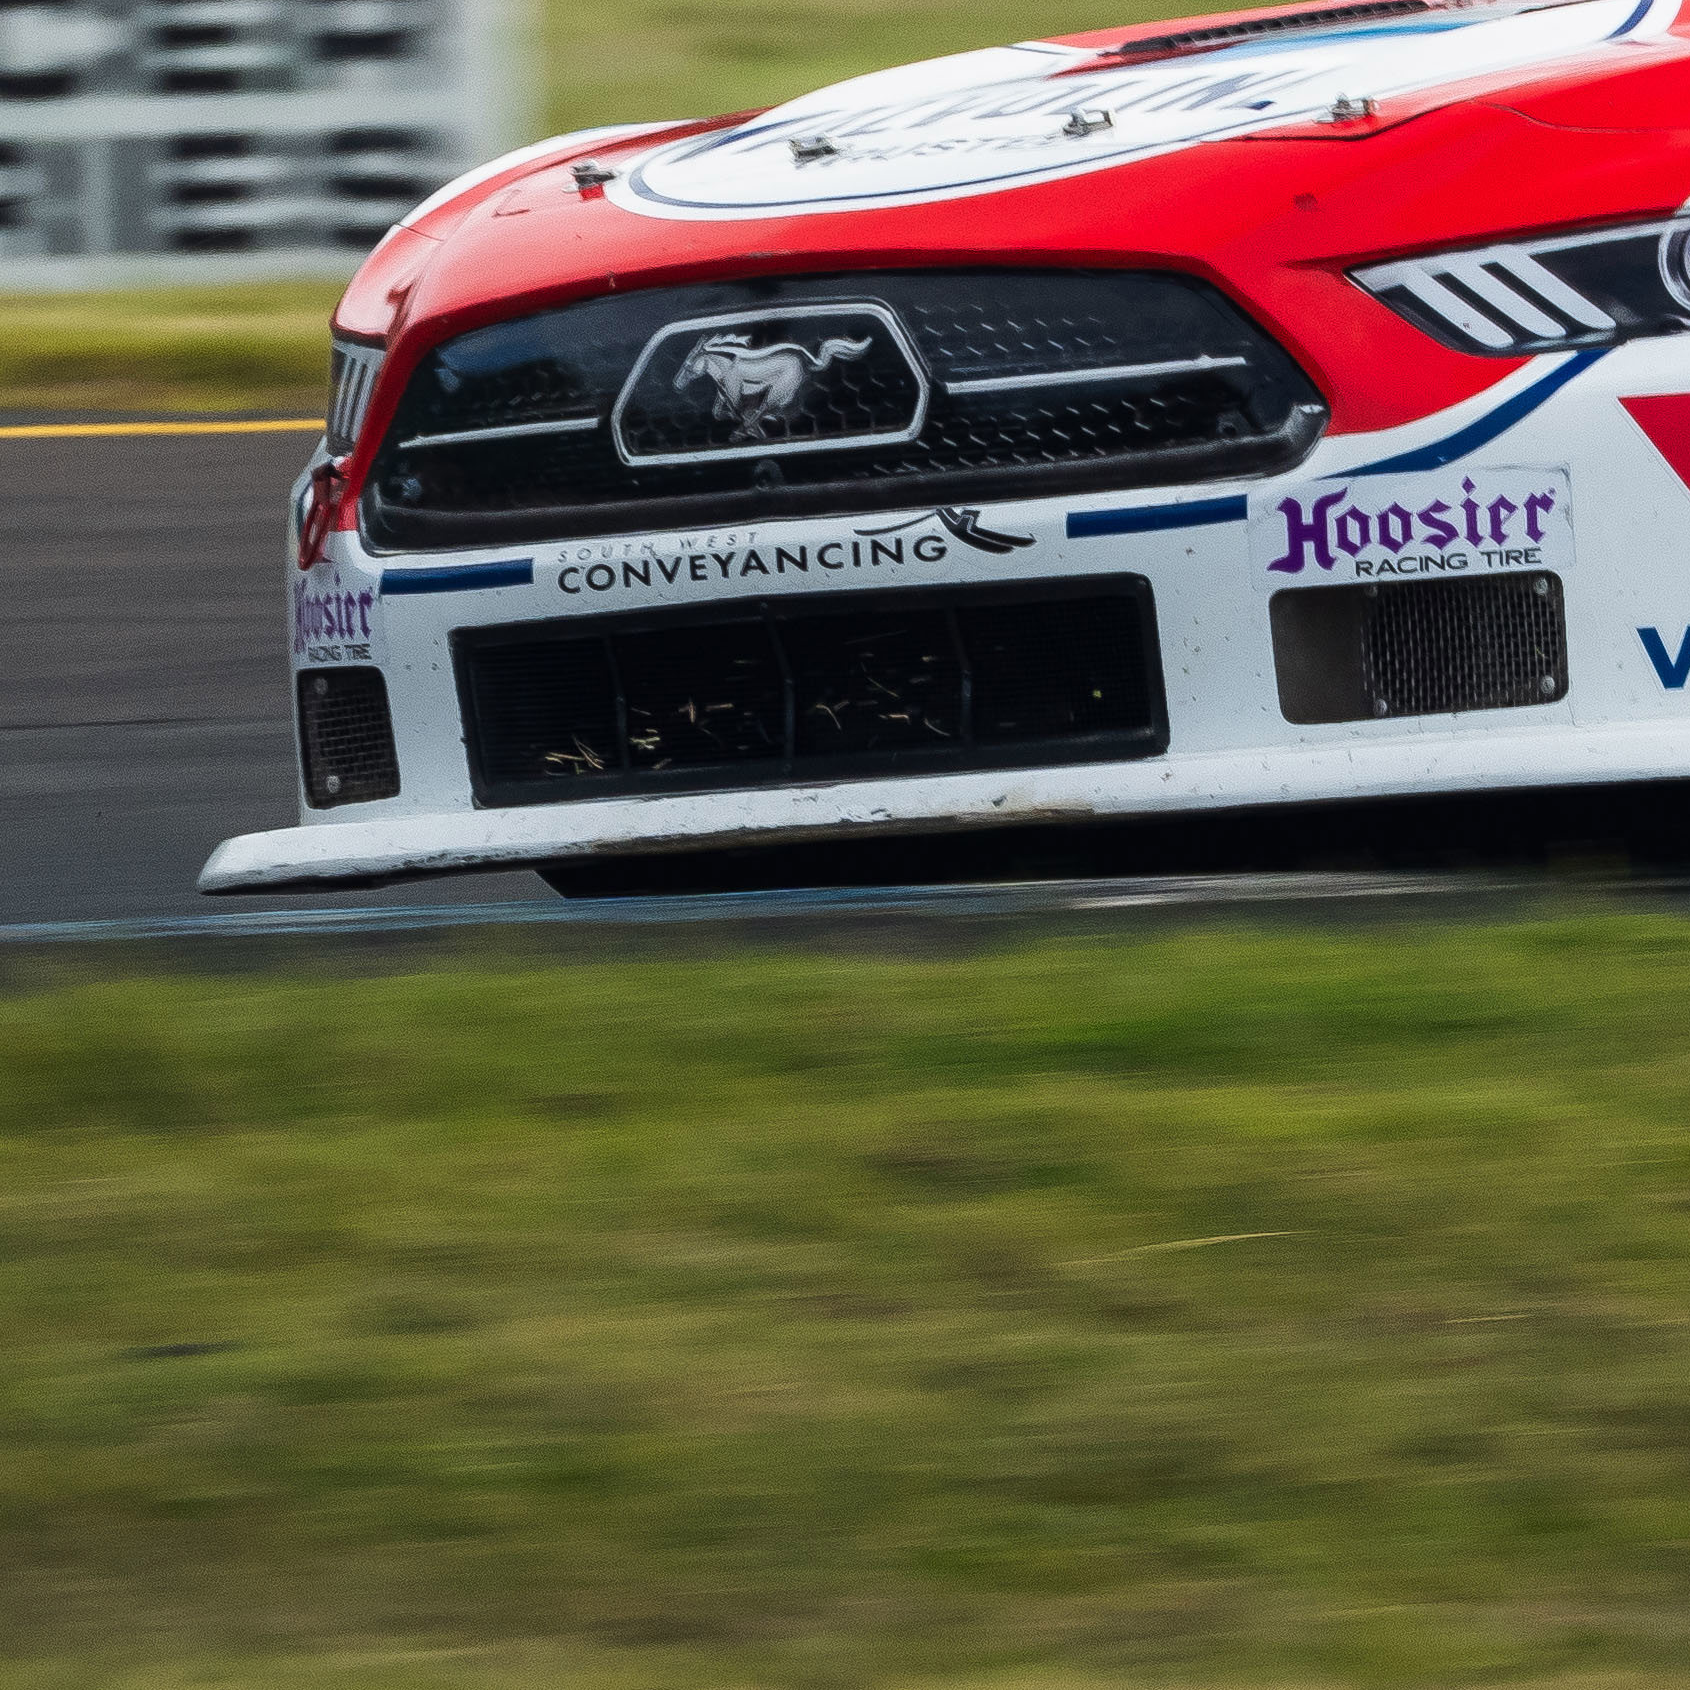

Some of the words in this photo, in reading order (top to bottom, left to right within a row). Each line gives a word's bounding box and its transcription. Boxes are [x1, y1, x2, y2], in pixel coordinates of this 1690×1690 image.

[557, 540, 657, 564] SOUTH
[678, 530, 758, 553] WEST
[1266, 474, 1556, 574] Hoosier
[557, 535, 948, 594] CONVEYANCING
[1355, 553, 1468, 577] RACING
[1480, 546, 1543, 568] TIRE
